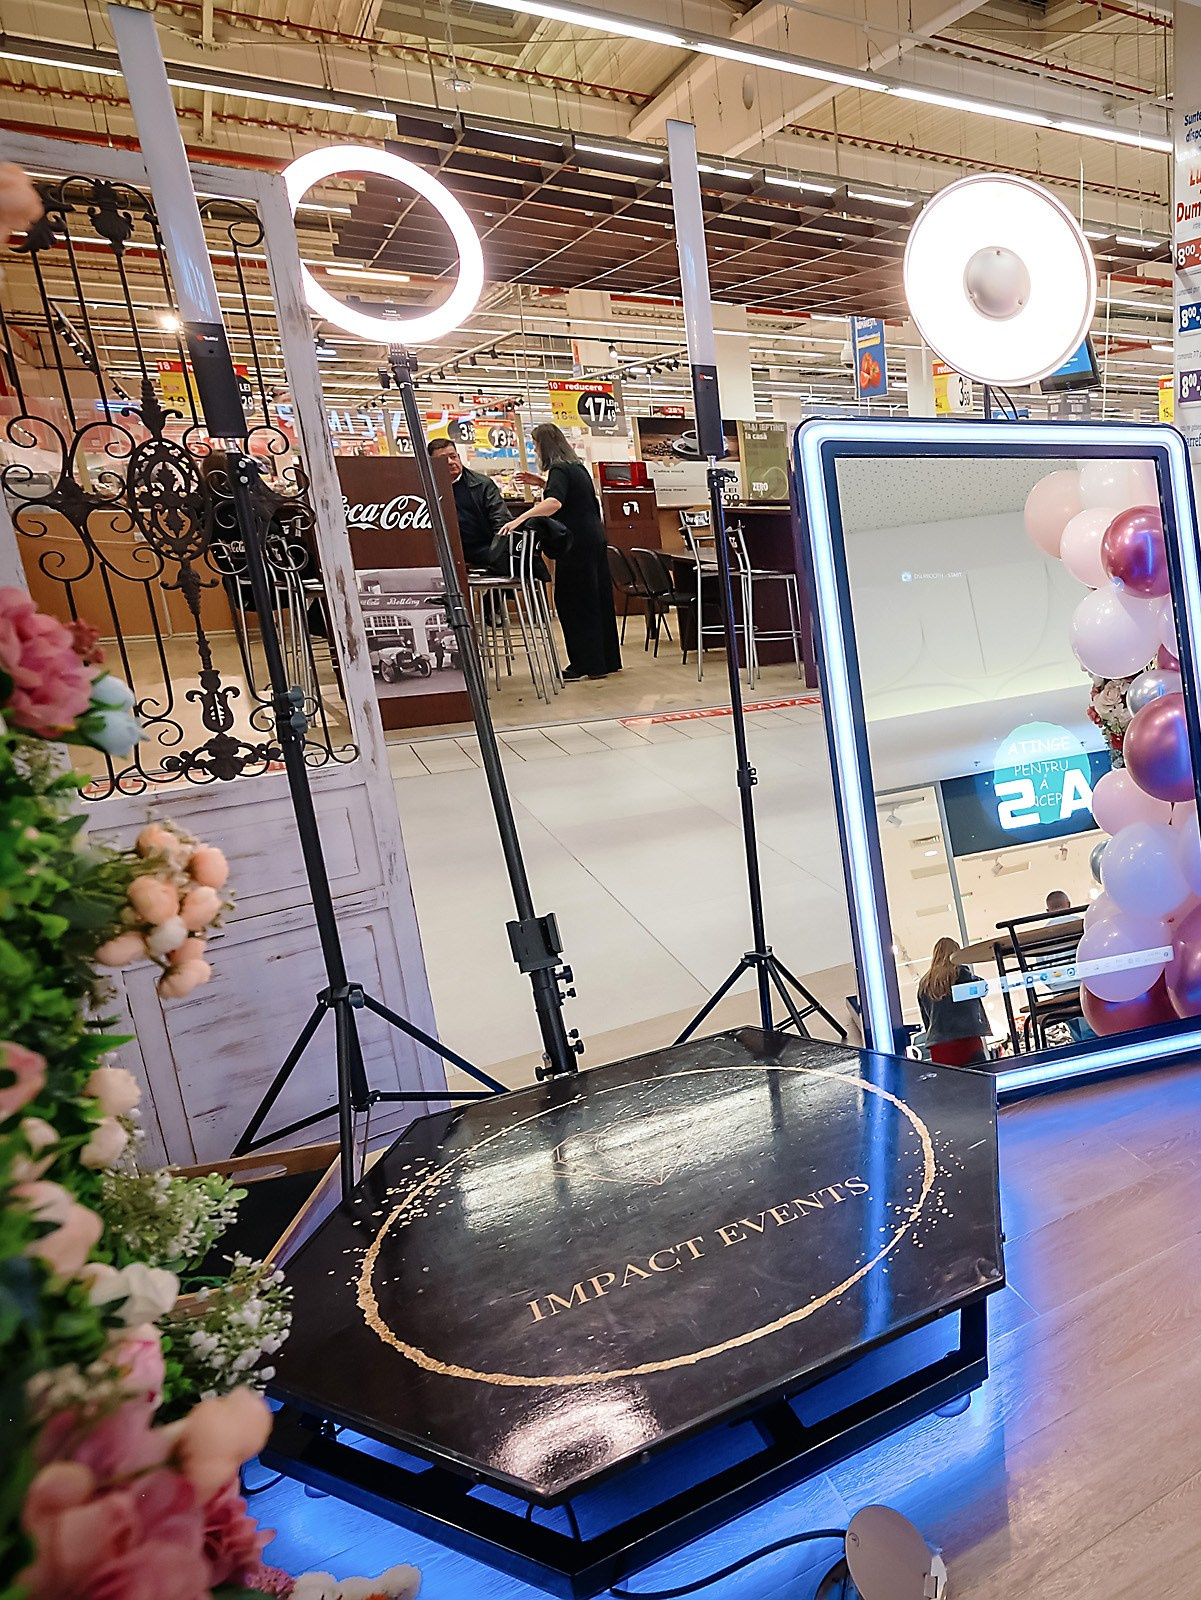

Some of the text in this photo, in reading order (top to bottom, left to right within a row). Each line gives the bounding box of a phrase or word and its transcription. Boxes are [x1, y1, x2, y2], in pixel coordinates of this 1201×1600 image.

[239, 383, 251, 392] LEI
[564, 382, 604, 391] reducere
[584, 396, 605, 422] 17
[752, 482, 769, 491] ZERO
[341, 495, 434, 530] oca-Col
[1008, 736, 1071, 756] ATINGE
[1014, 759, 1069, 776] PENTRU
[526, 1237, 706, 1324] IMPACT
[714, 1176, 871, 1247] EVENTS
